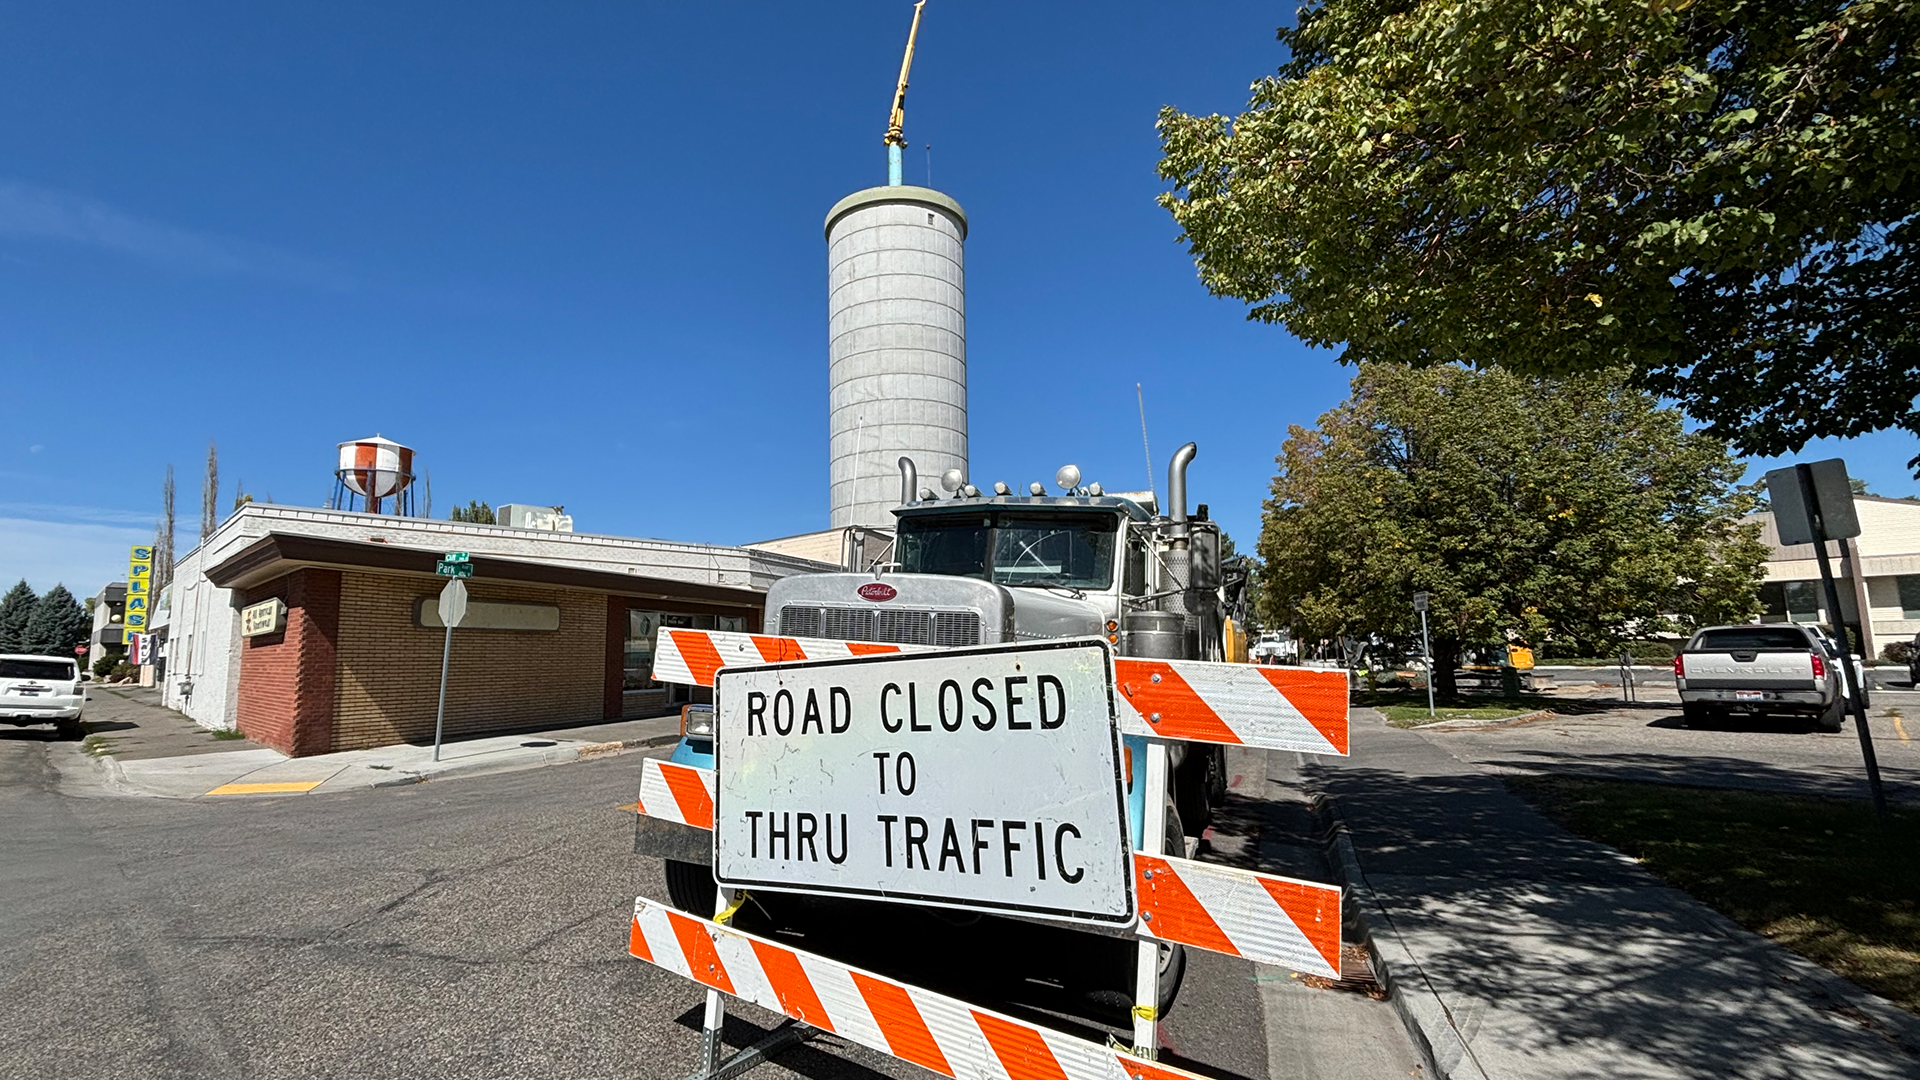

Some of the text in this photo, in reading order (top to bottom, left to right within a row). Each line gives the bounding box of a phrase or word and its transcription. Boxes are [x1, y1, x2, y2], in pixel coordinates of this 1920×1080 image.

[438, 562, 455, 575] Park
[747, 674, 1067, 737] ROAD CLOSED
[873, 752, 917, 796] TO
[745, 811, 1085, 884] THRU TRAFFIC
